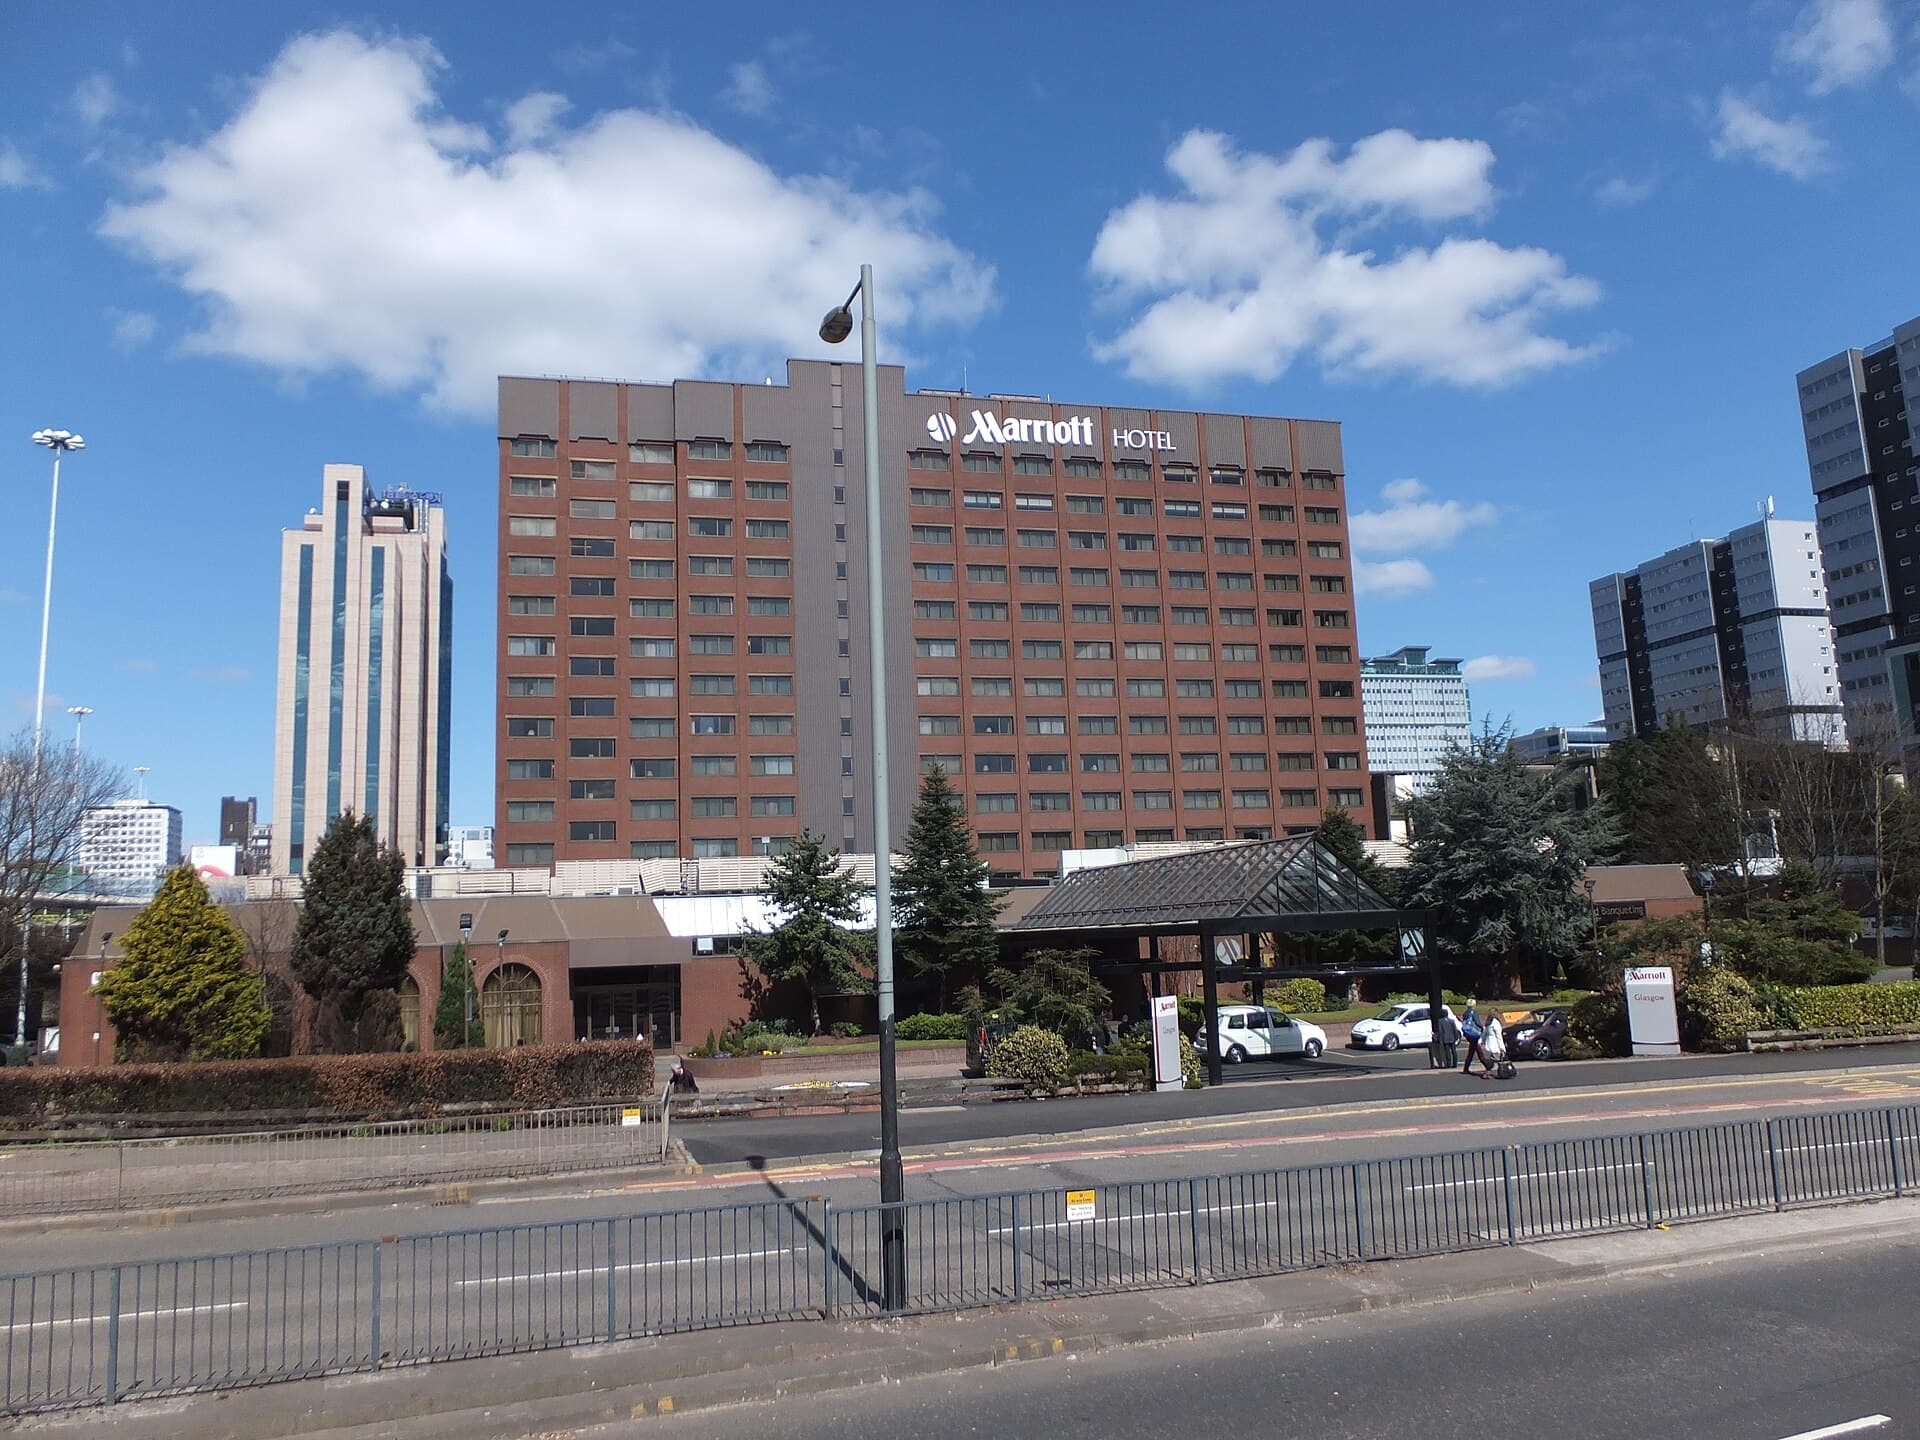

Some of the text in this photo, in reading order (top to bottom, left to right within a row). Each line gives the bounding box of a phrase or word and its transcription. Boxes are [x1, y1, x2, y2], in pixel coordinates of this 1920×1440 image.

[962, 408, 1177, 450] Marriott HOTEL
[1630, 972, 1666, 981] Marriott
[1634, 994, 1664, 1002] Glasgow
